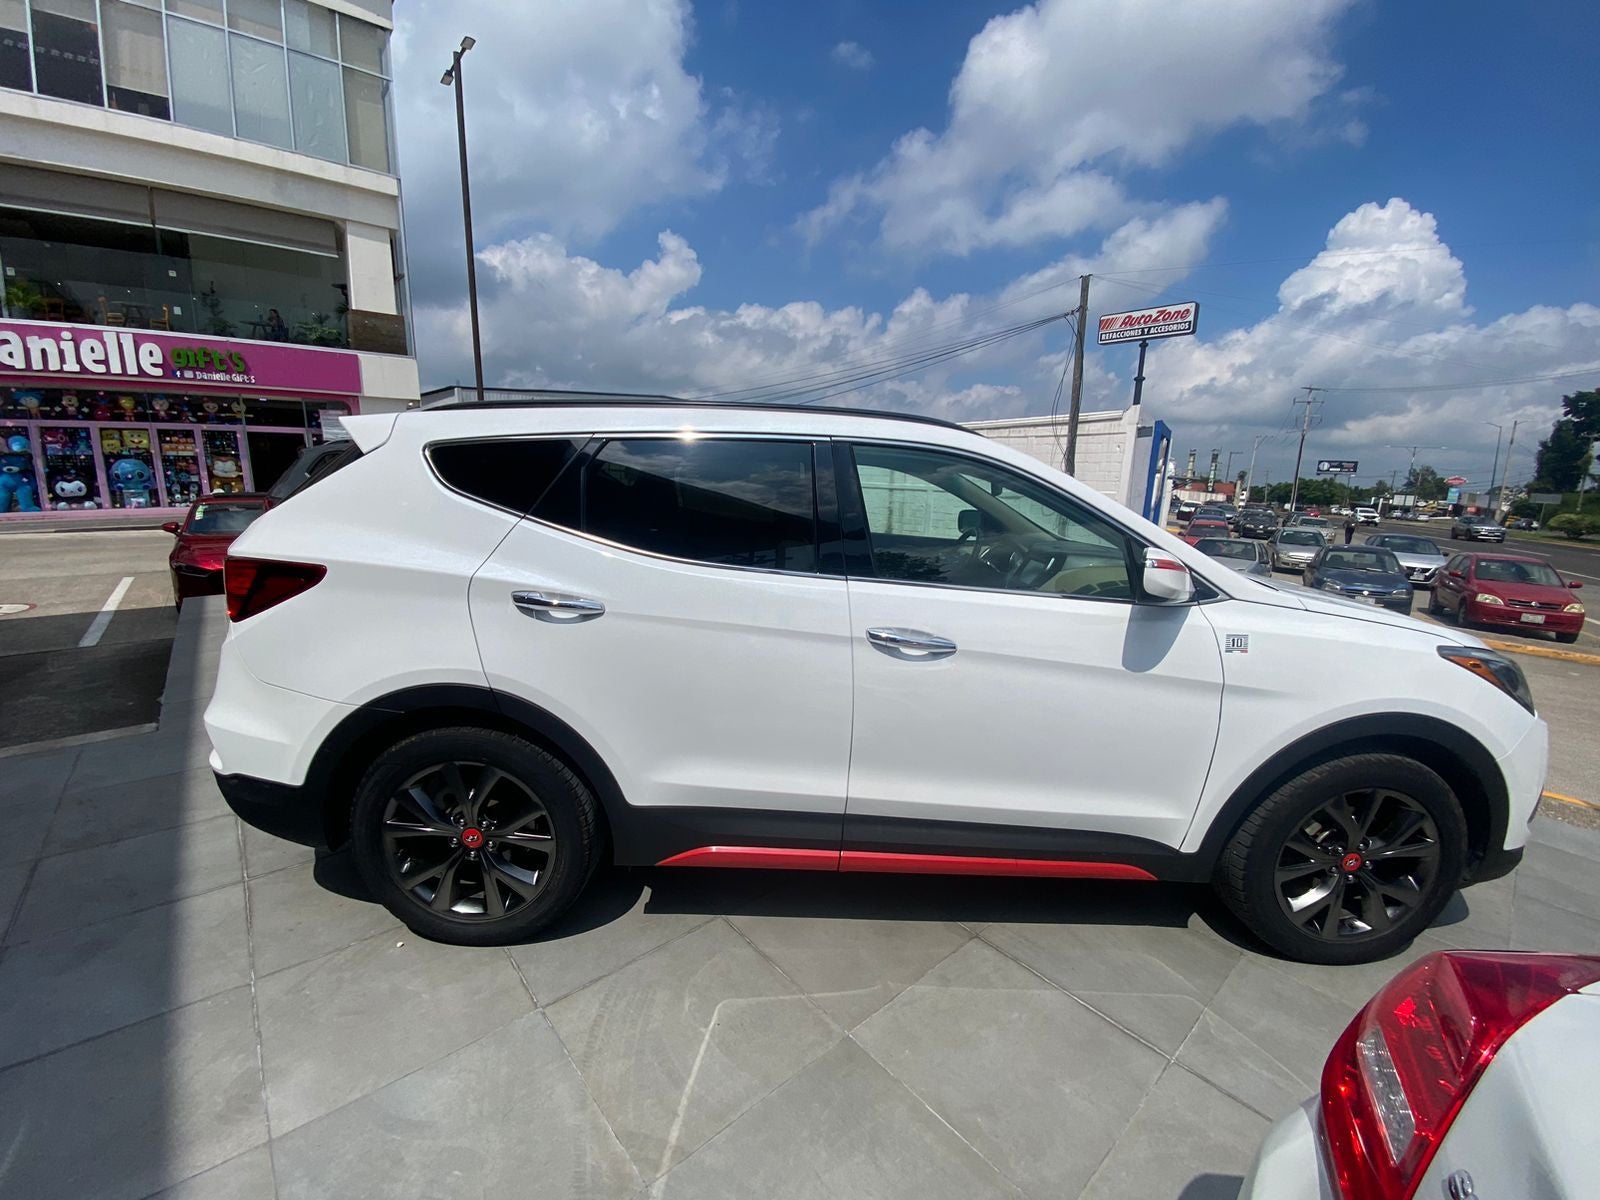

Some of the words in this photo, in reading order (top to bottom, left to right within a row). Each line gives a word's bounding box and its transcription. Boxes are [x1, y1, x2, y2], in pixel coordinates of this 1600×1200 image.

[1120, 308, 1192, 328] AutoZone
[1101, 328, 1142, 340] REFACCIONES
[1144, 327, 1149, 335] Y
[1150, 322, 1189, 334] ACCESORIOS
